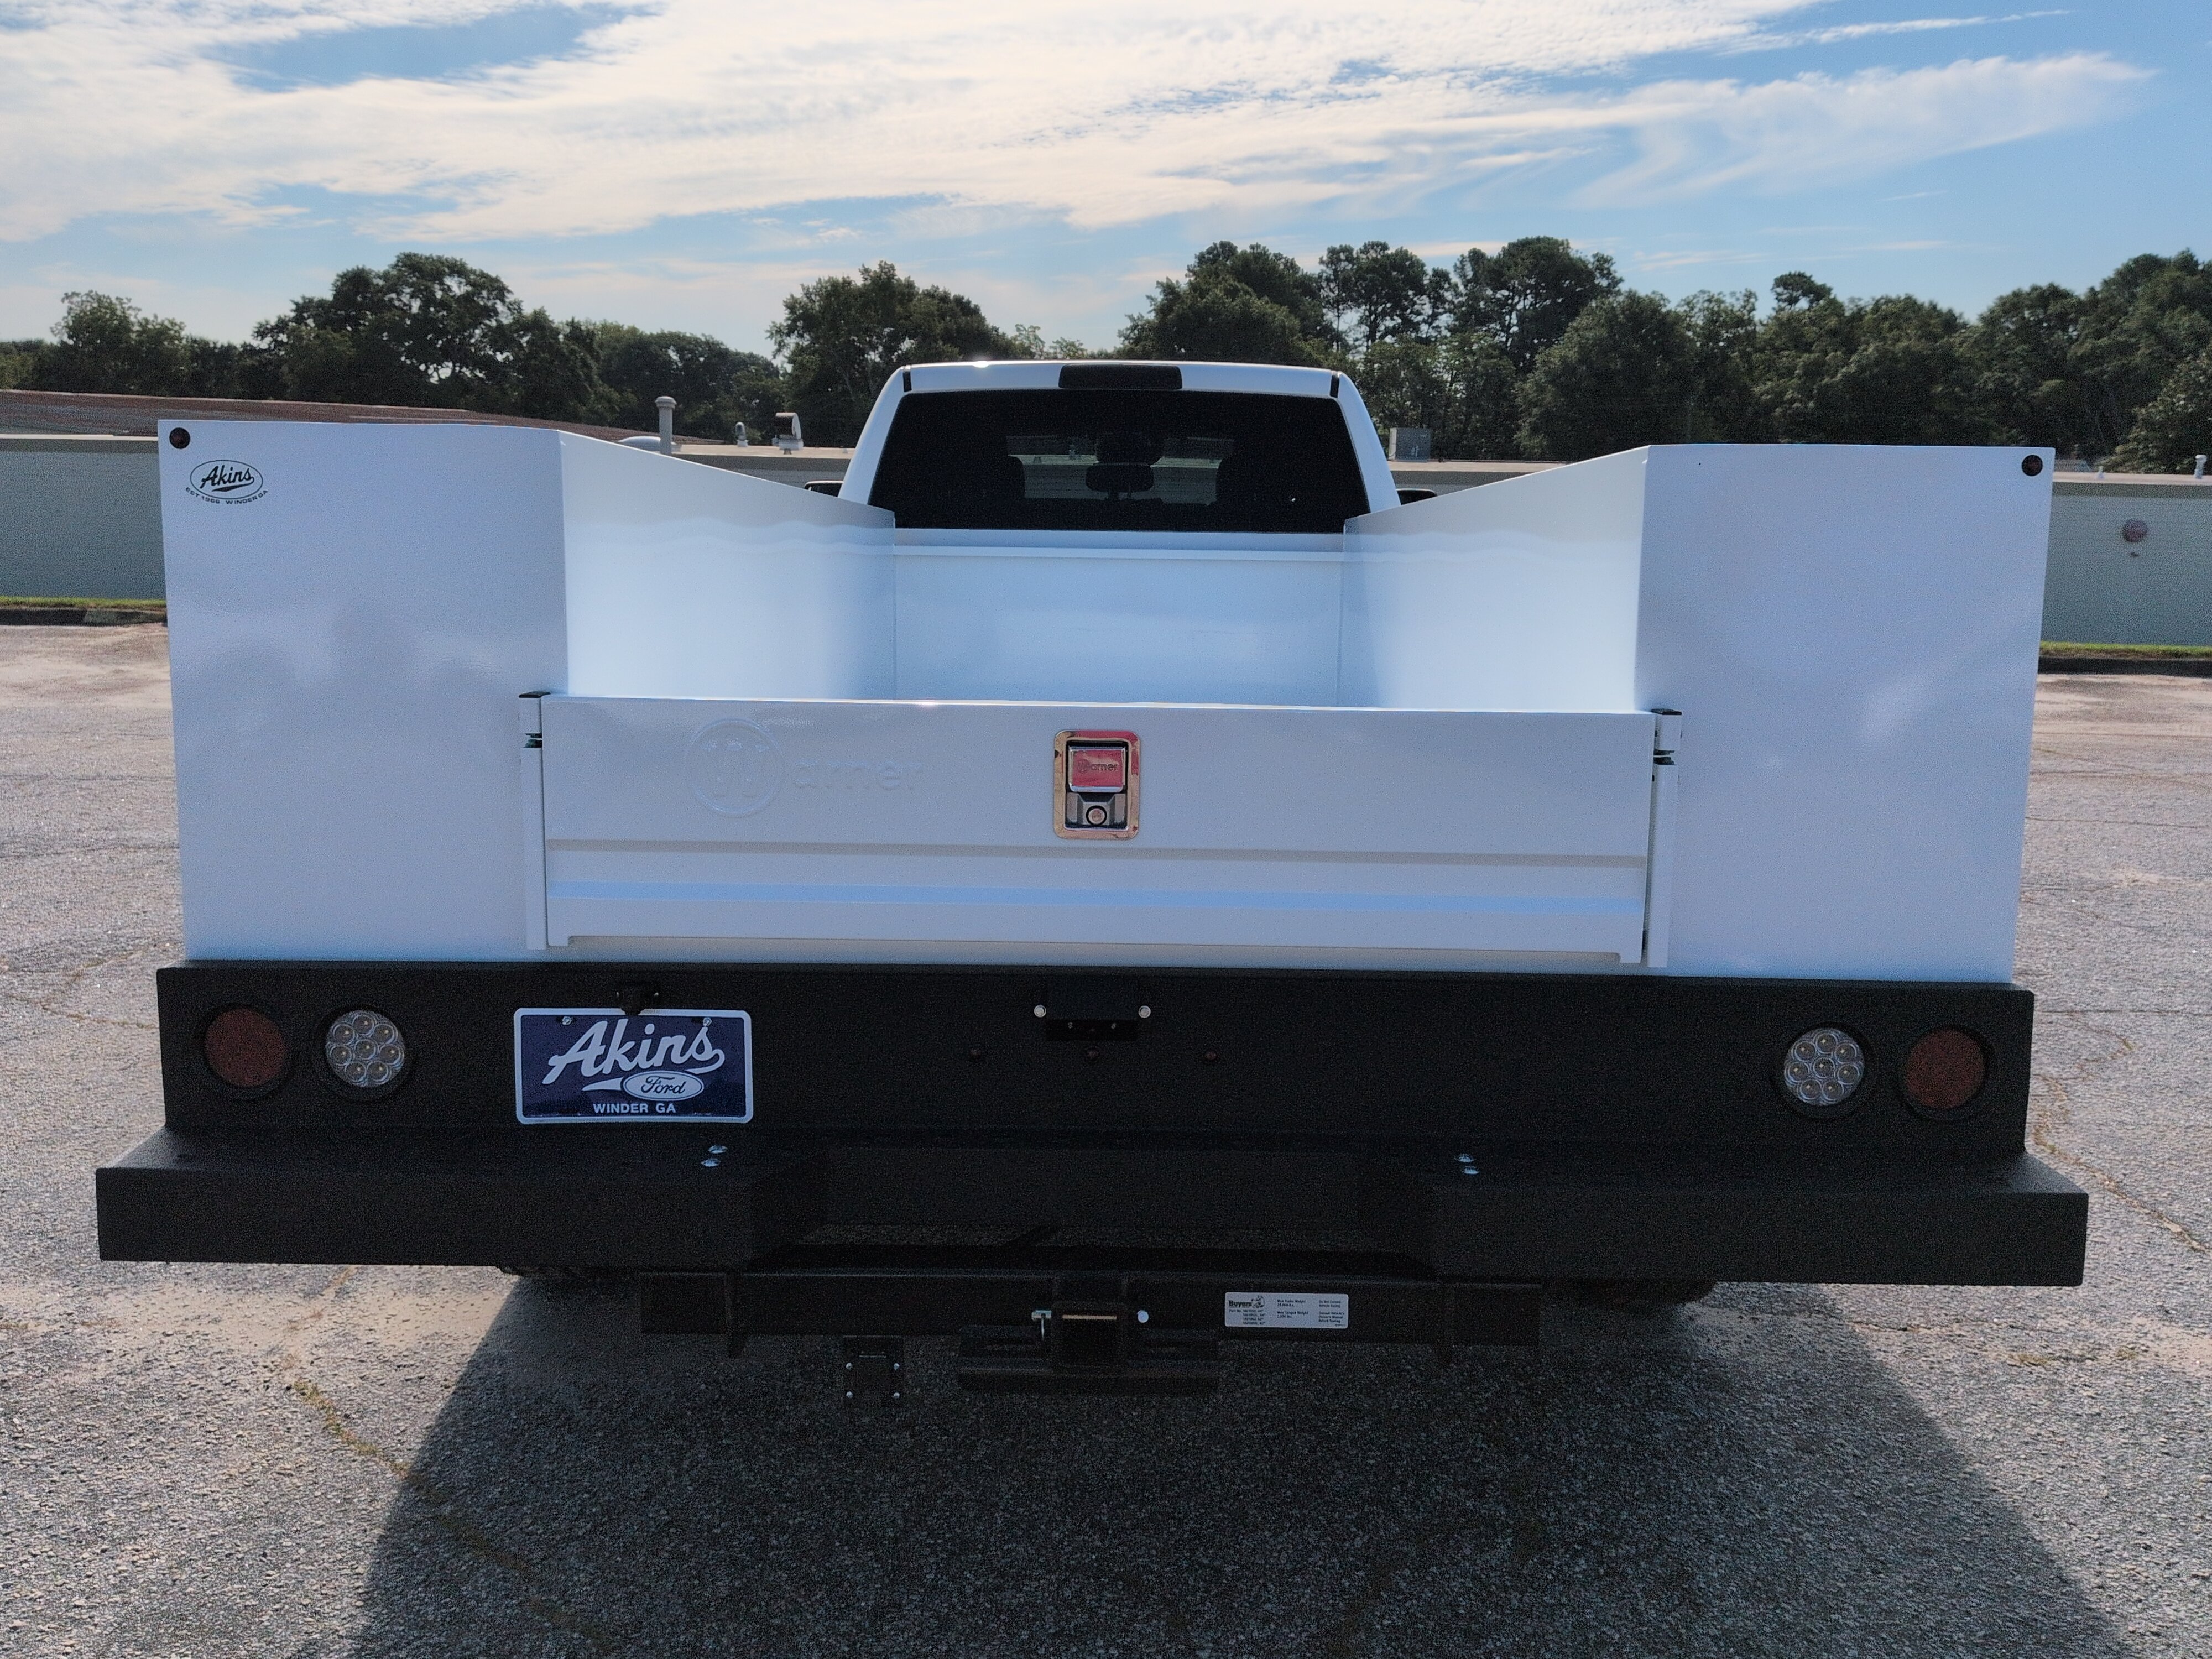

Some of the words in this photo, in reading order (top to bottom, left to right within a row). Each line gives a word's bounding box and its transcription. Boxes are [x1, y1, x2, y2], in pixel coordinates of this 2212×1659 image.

[200, 465, 254, 489] Akins
[186, 487, 200, 497] EST
[226, 495, 258, 504] WINDER
[258, 490, 268, 498] GA
[542, 1018, 725, 1084] Akins
[641, 1075, 685, 1094] Ford
[593, 1103, 649, 1114] WINDER
[655, 1103, 676, 1113] GA
